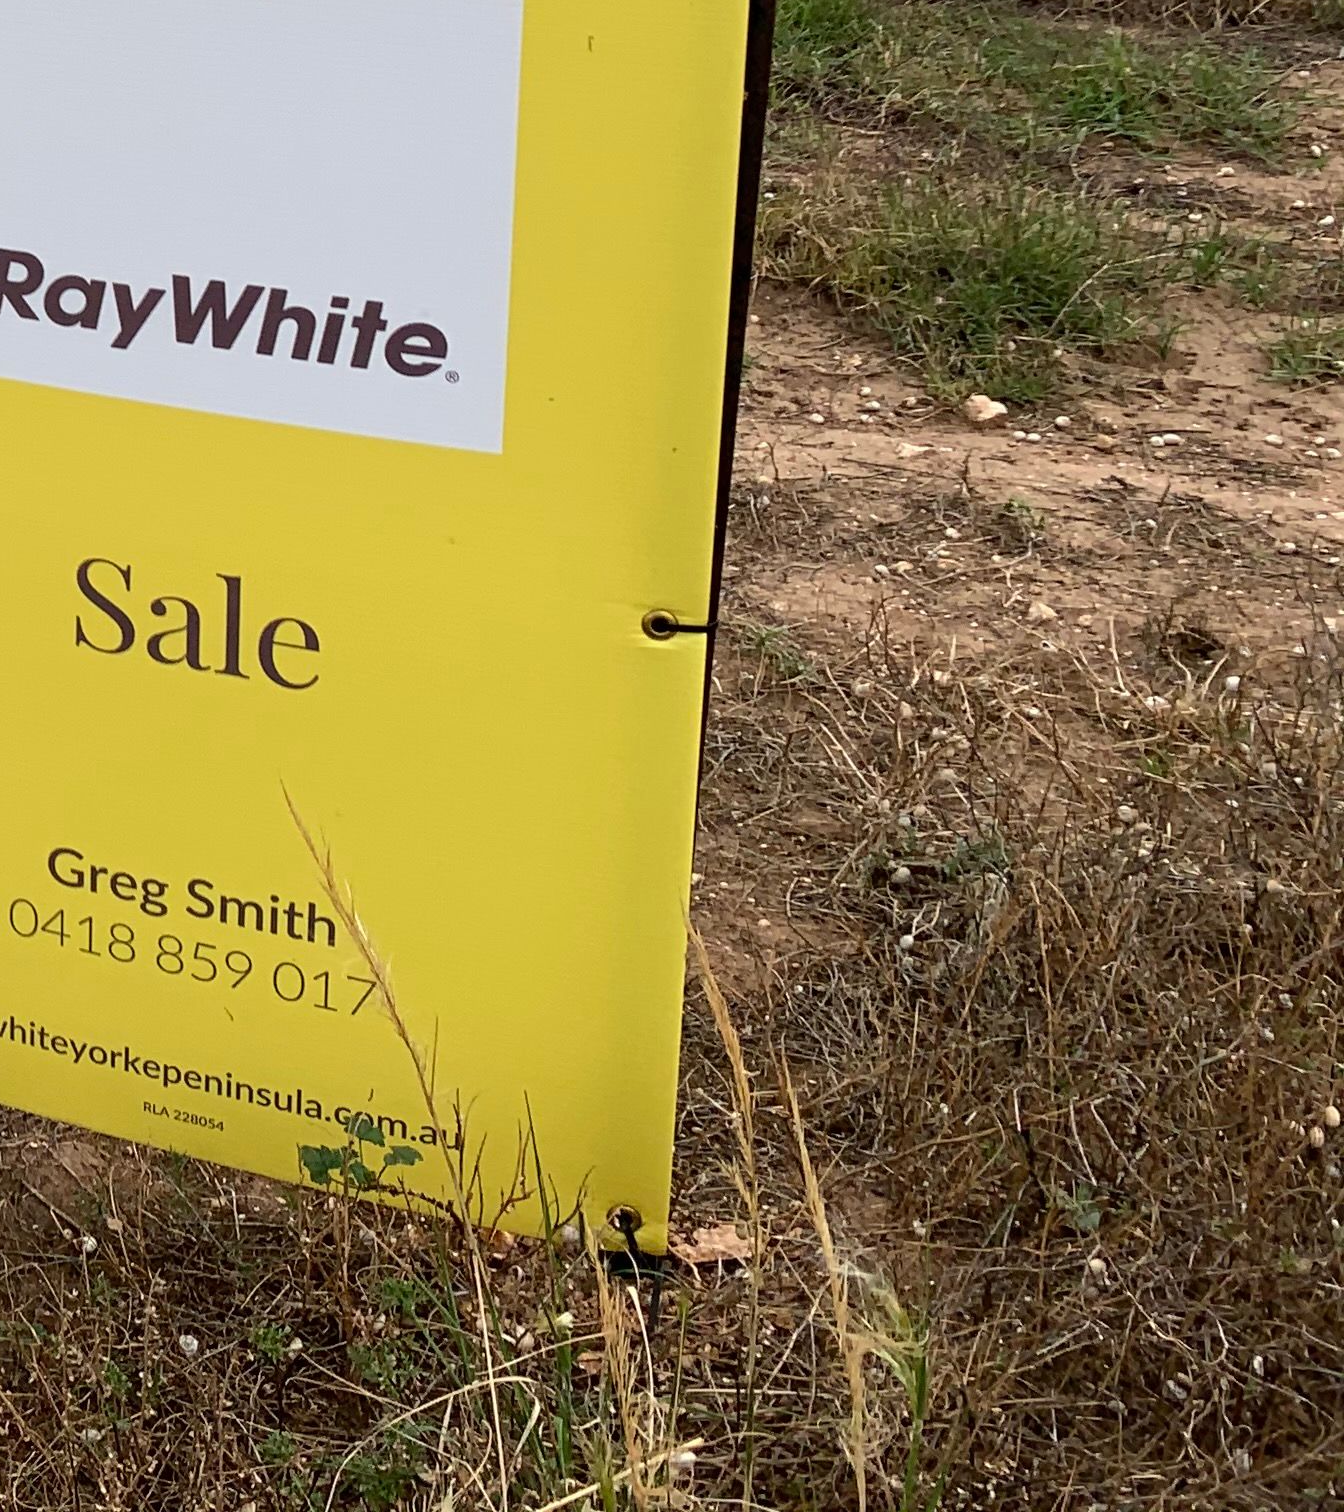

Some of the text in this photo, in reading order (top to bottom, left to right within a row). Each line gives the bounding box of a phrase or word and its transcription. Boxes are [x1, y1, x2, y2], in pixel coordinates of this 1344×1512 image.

[75, 557, 320, 690] Sale
[47, 847, 338, 947] Greg Smith
[9, 898, 379, 1016] 0418 859 017
[143, 1101, 225, 1133] RLA 228054
